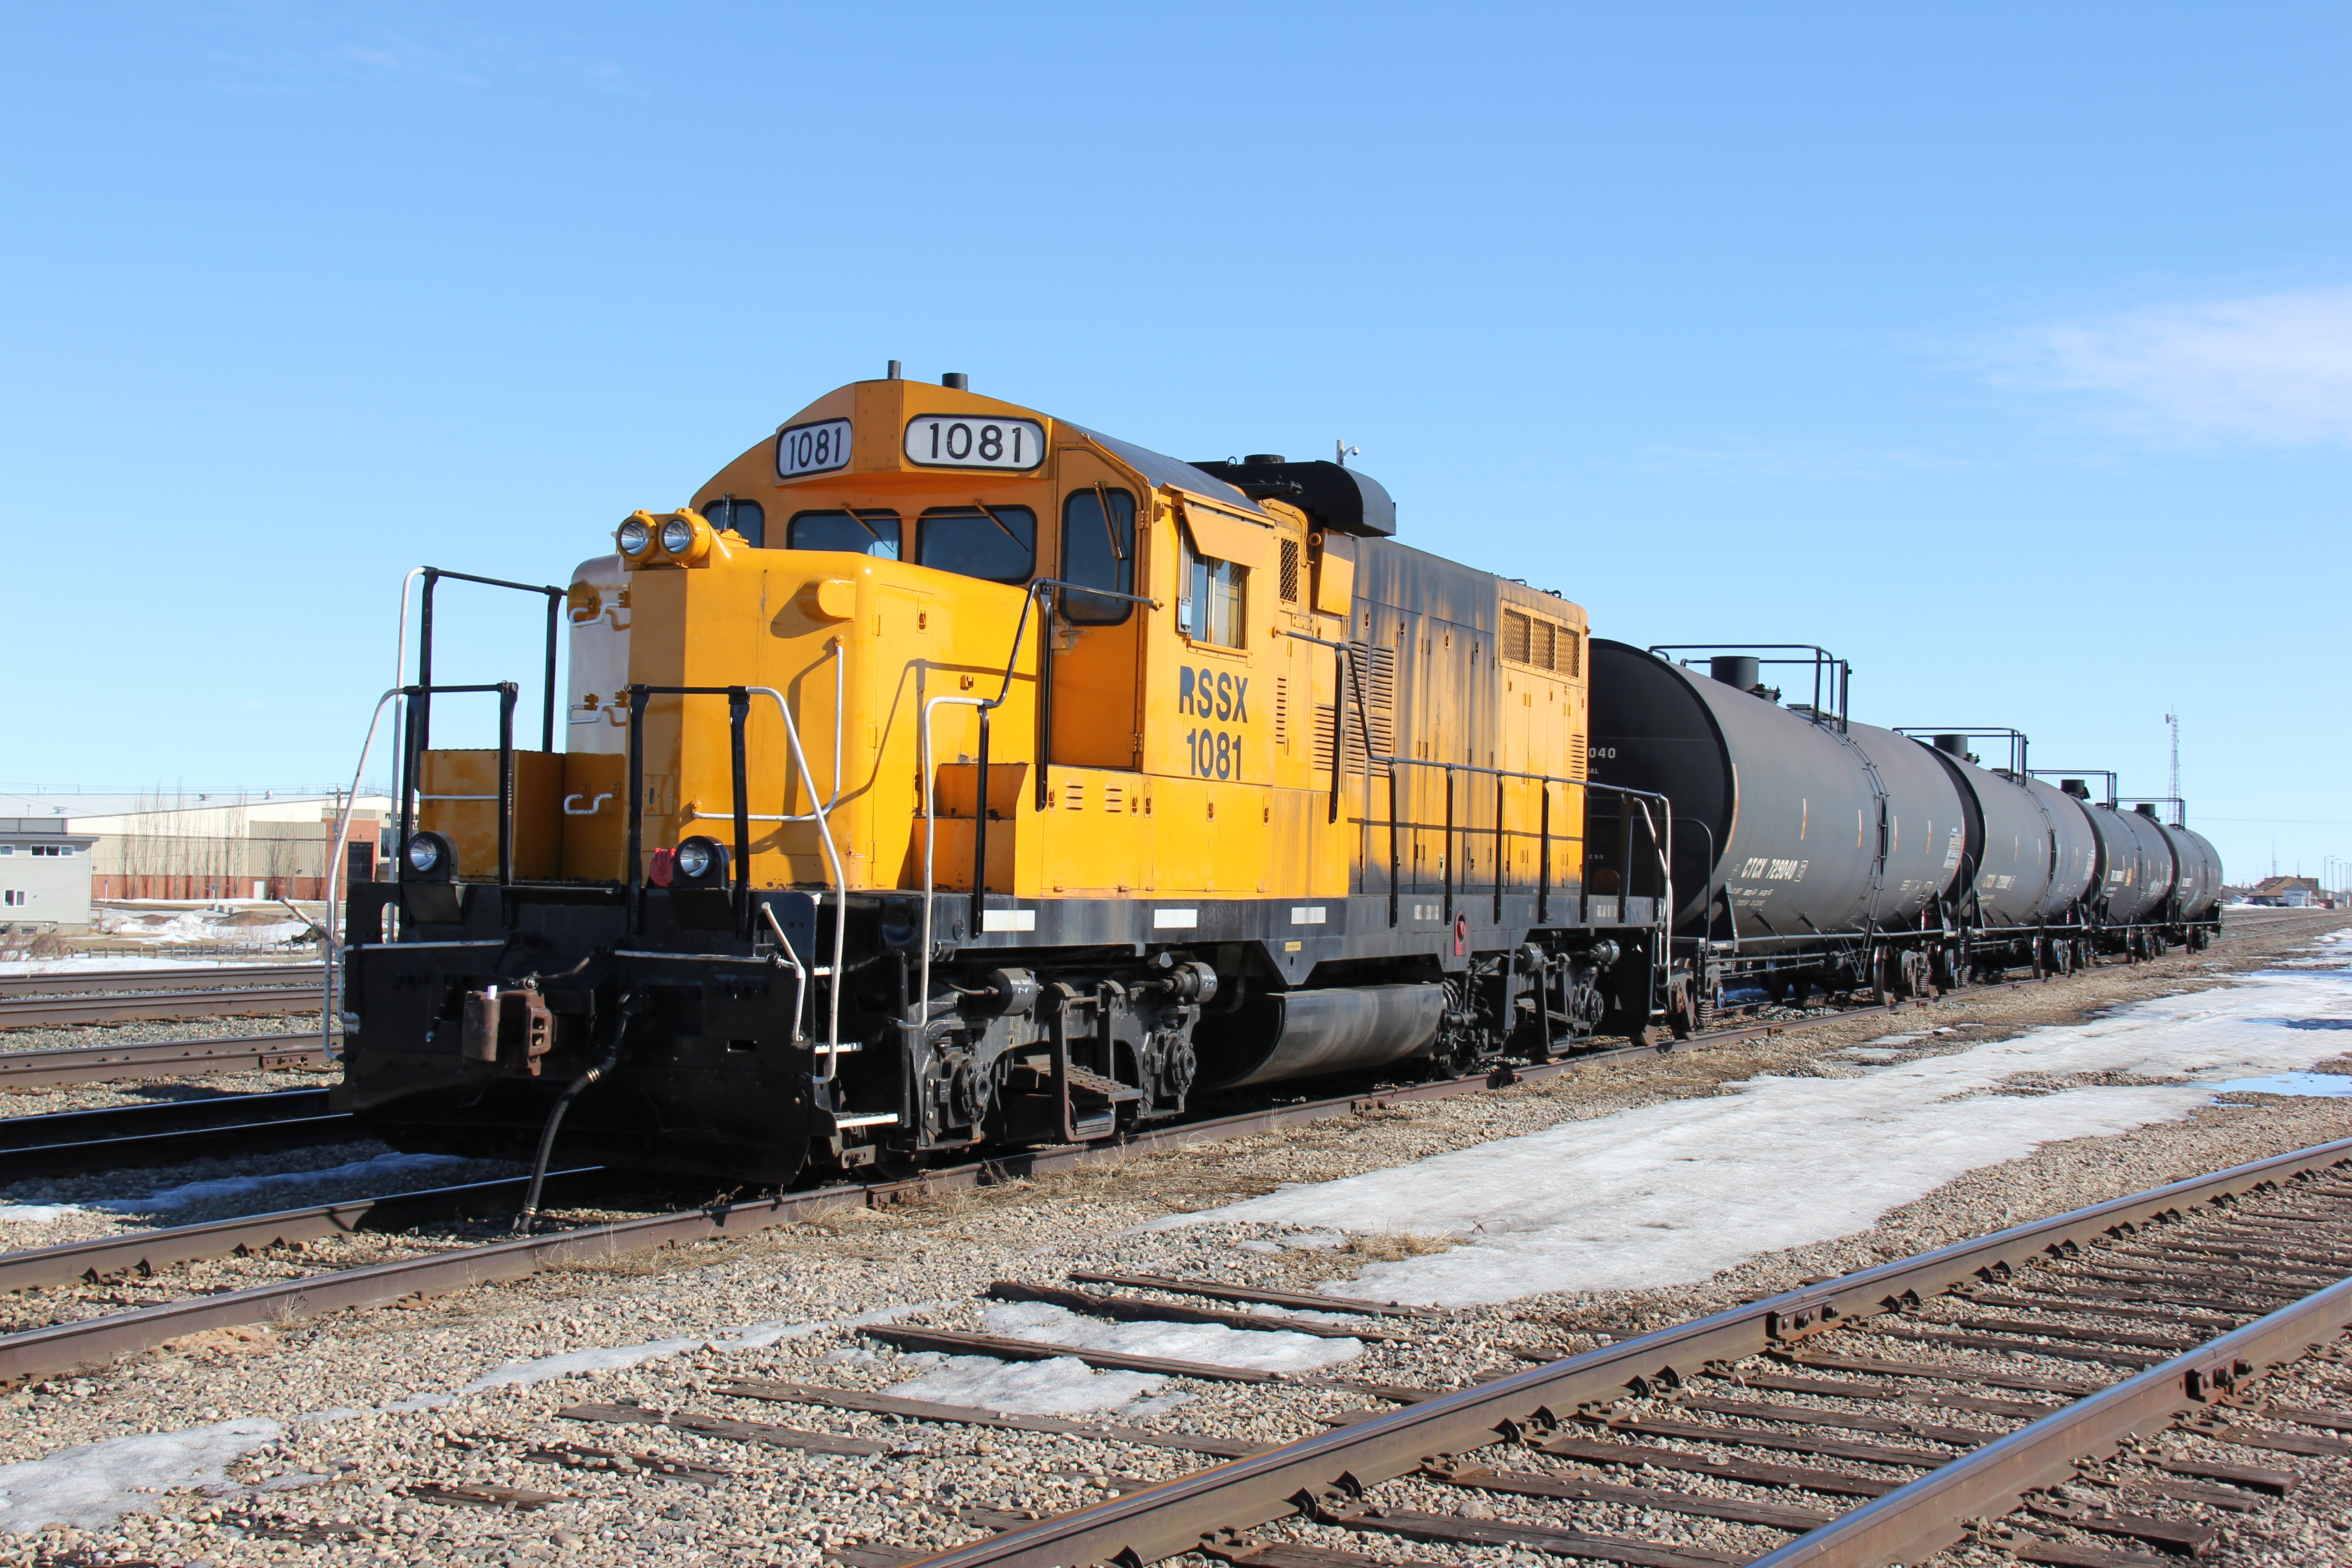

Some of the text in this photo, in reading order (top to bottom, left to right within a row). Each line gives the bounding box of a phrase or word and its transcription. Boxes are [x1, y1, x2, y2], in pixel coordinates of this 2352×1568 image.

[789, 426, 841, 470] 1081
[930, 423, 1022, 463] 1081
[1179, 666, 1249, 724] RSSX
[1186, 728, 1242, 781] 1081
[1740, 857, 1769, 878] CTCX
[1765, 859, 1798, 880] 729040
